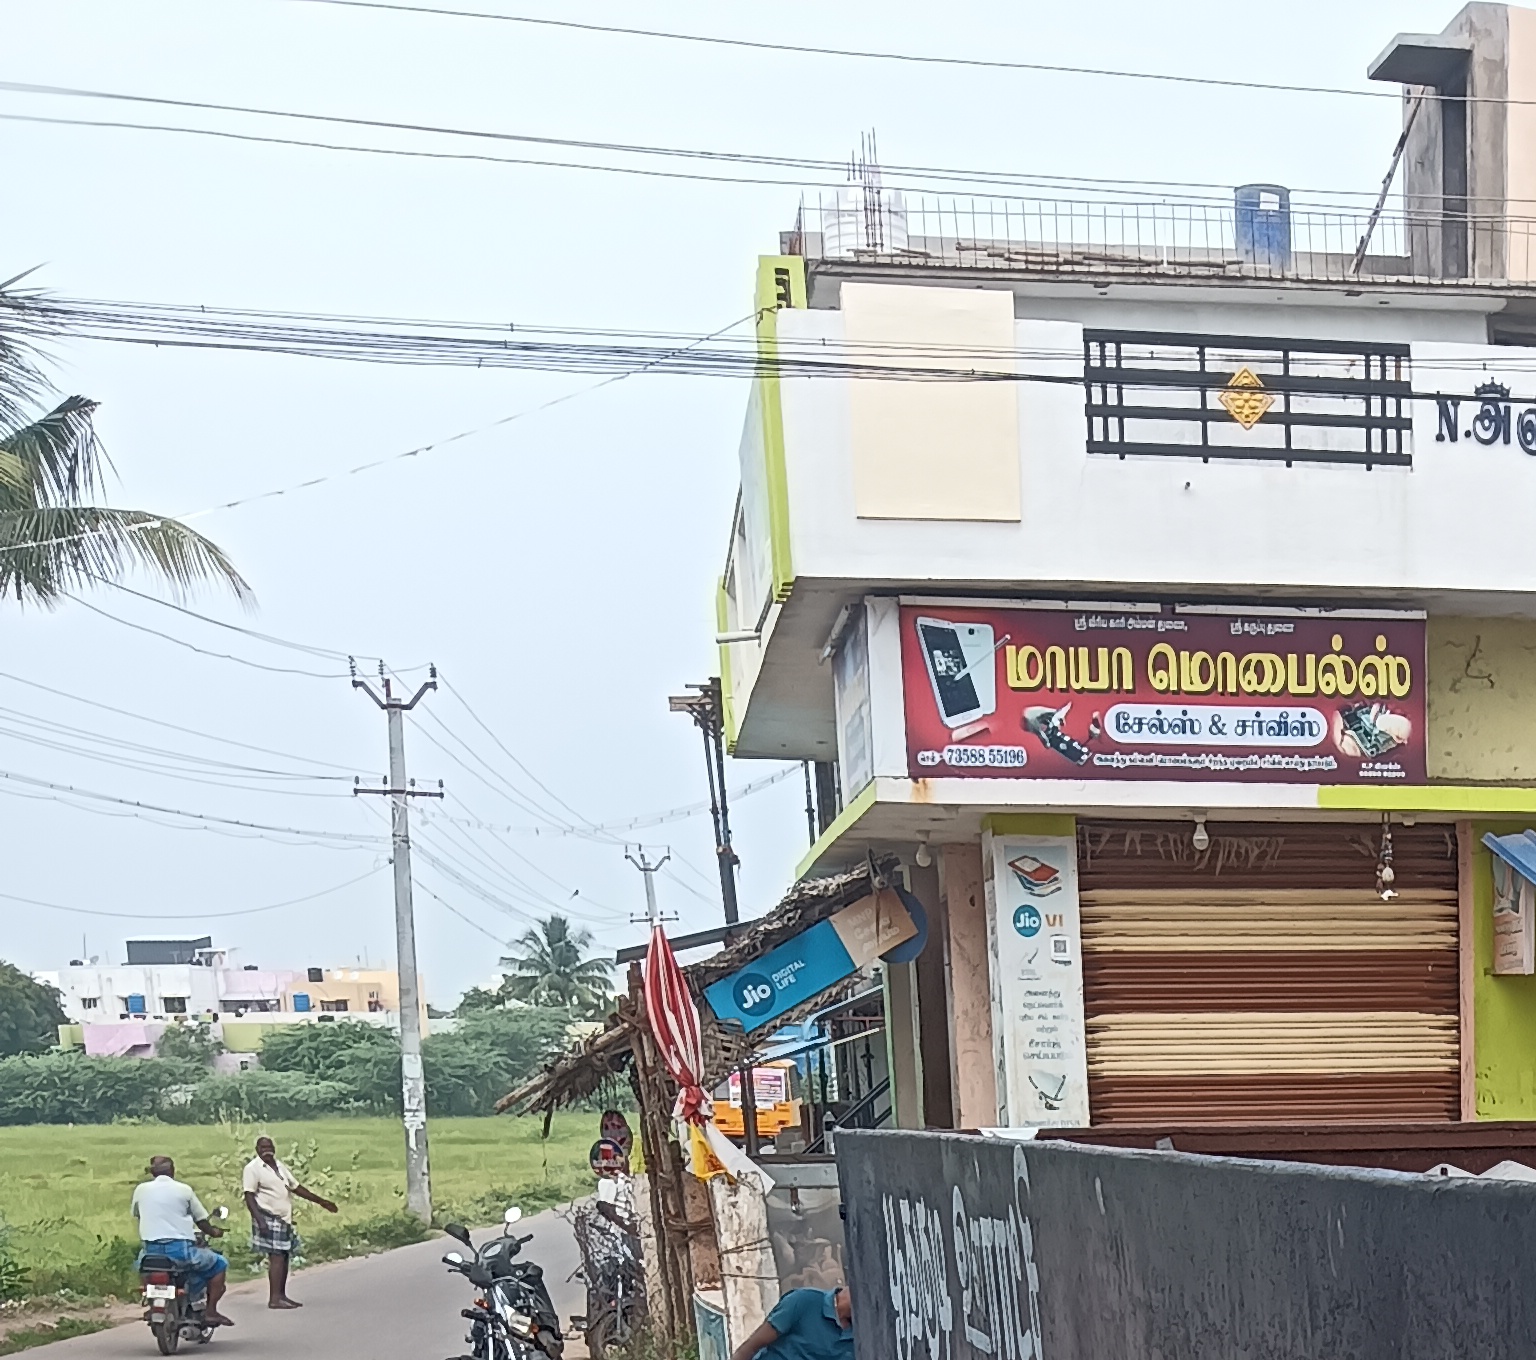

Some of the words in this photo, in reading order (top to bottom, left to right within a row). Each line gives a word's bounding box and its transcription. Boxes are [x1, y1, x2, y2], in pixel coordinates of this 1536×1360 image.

[1004, 643, 1135, 693] மாயா
[1147, 633, 1412, 699] மொபைல்ஸ்
[1115, 709, 1202, 736] சேல்ஸ்
[1208, 713, 1228, 736] &
[1234, 710, 1320, 738] சர்வீஸ்
[946, 748, 986, 764] 73588
[988, 748, 1025, 765] 55196
[772, 960, 805, 983] DIGITAL
[775, 974, 797, 990] LIFE
[742, 984, 771, 1009] Jio
